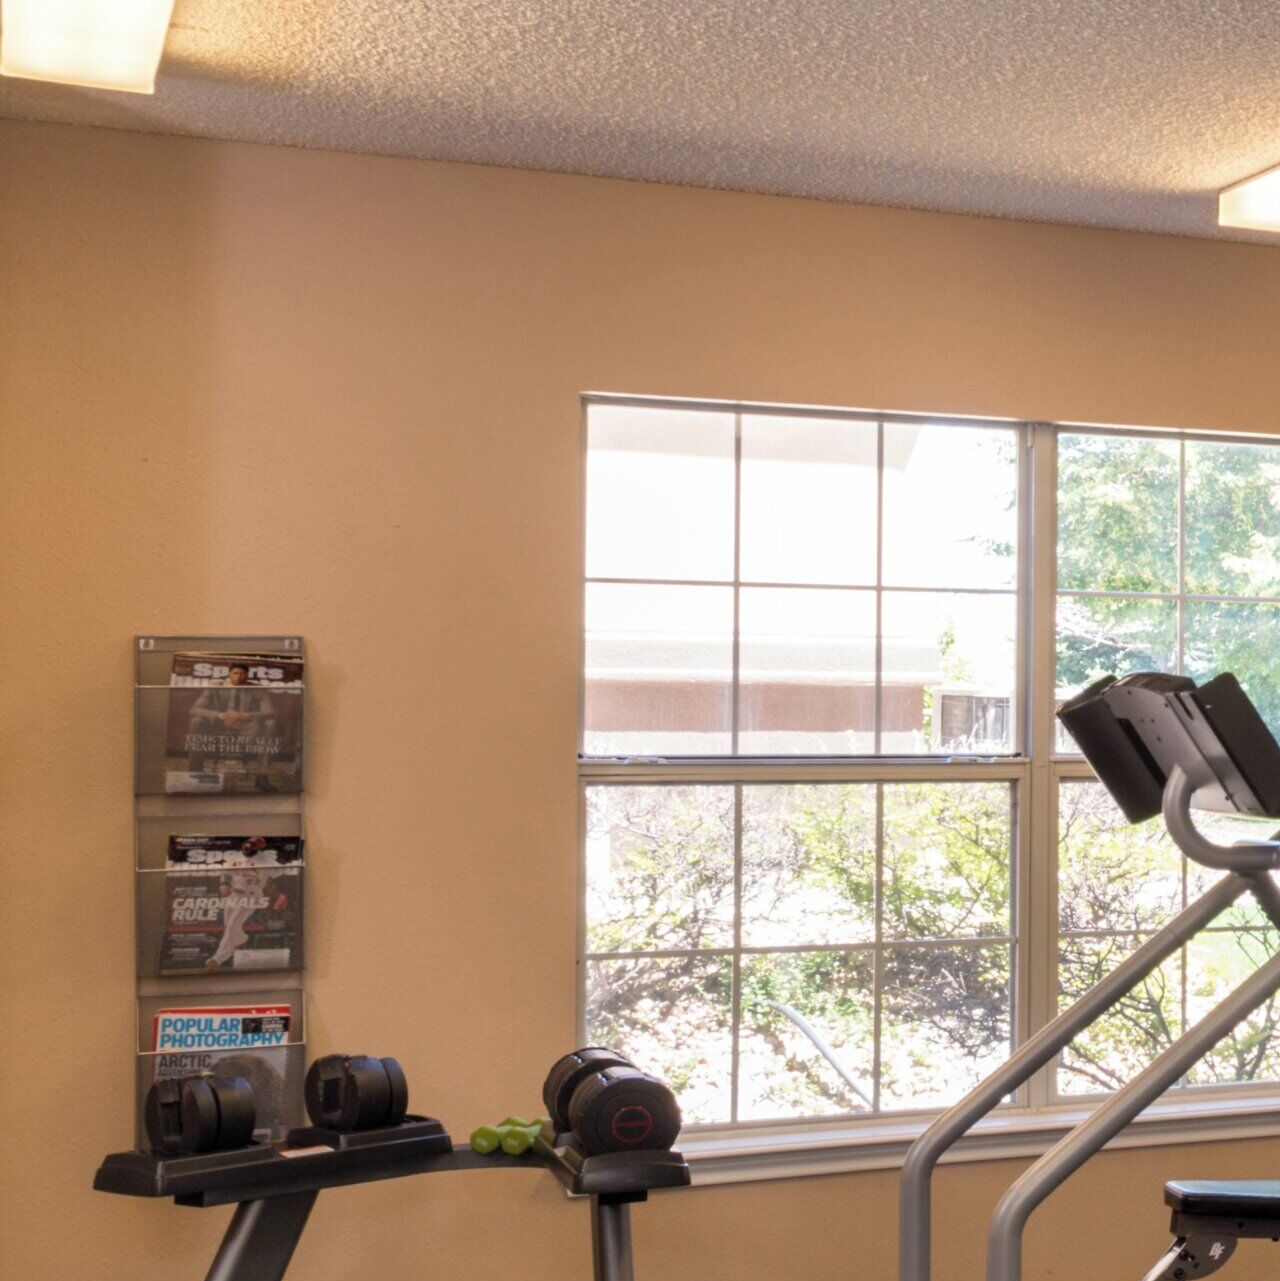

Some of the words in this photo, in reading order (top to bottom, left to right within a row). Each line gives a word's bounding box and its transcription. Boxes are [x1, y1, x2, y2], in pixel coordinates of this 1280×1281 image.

[193, 663, 284, 679] Sprts
[172, 897, 270, 909] CARDINALS
[171, 908, 219, 921] RULE
[161, 1018, 241, 1033] POPULAR
[159, 1031, 285, 1048] PHOTOGRAPHY
[158, 1054, 213, 1069] ARCTIC
